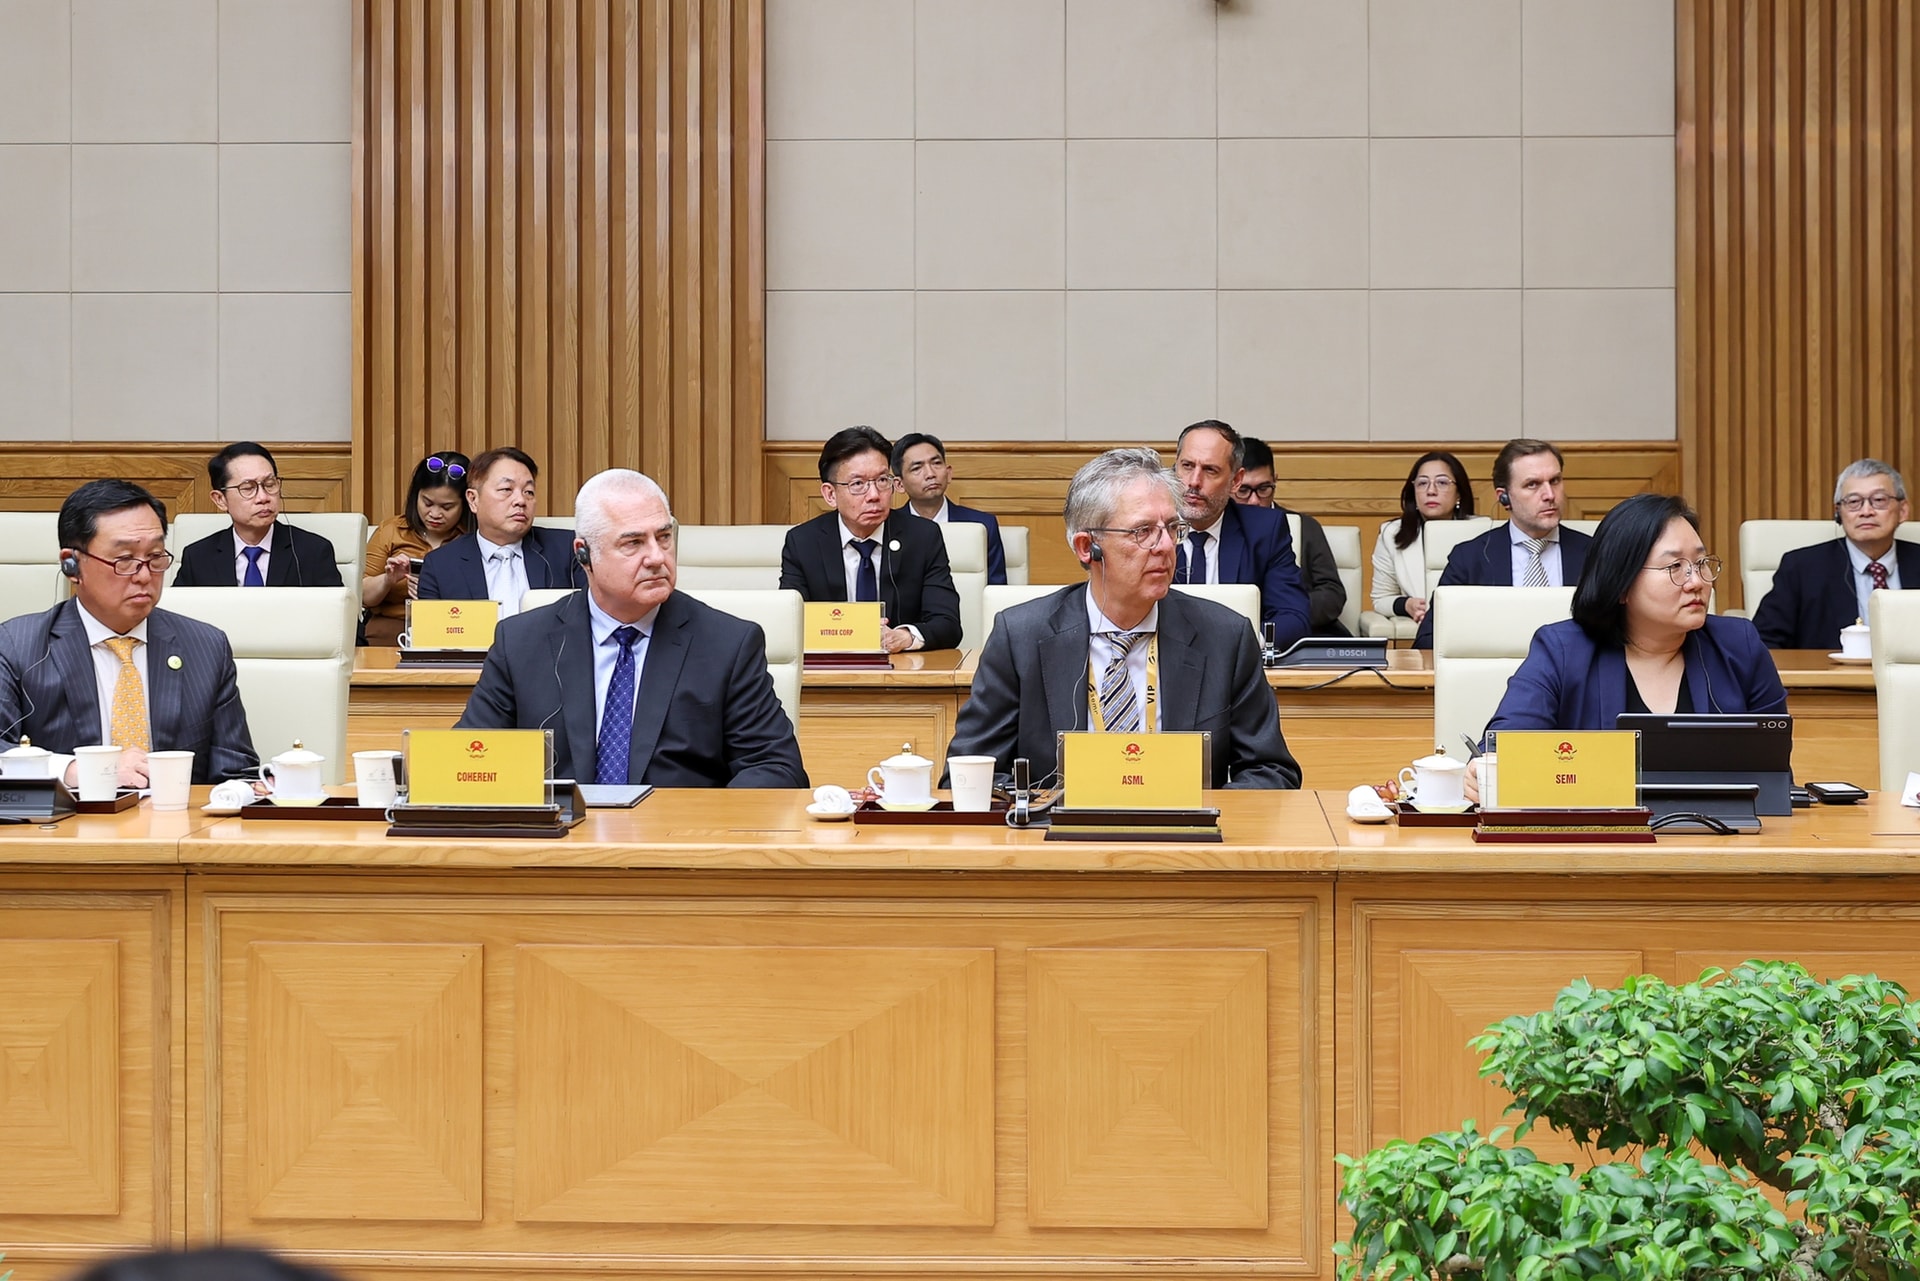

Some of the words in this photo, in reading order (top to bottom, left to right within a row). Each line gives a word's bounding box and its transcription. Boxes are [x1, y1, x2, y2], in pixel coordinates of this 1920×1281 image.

[1339, 649, 1367, 657] BOSCH
[1147, 685, 1155, 704] VIP
[456, 772, 497, 782] COHERENT
[1121, 775, 1145, 785] ASML
[1555, 774, 1577, 784] SEMI
